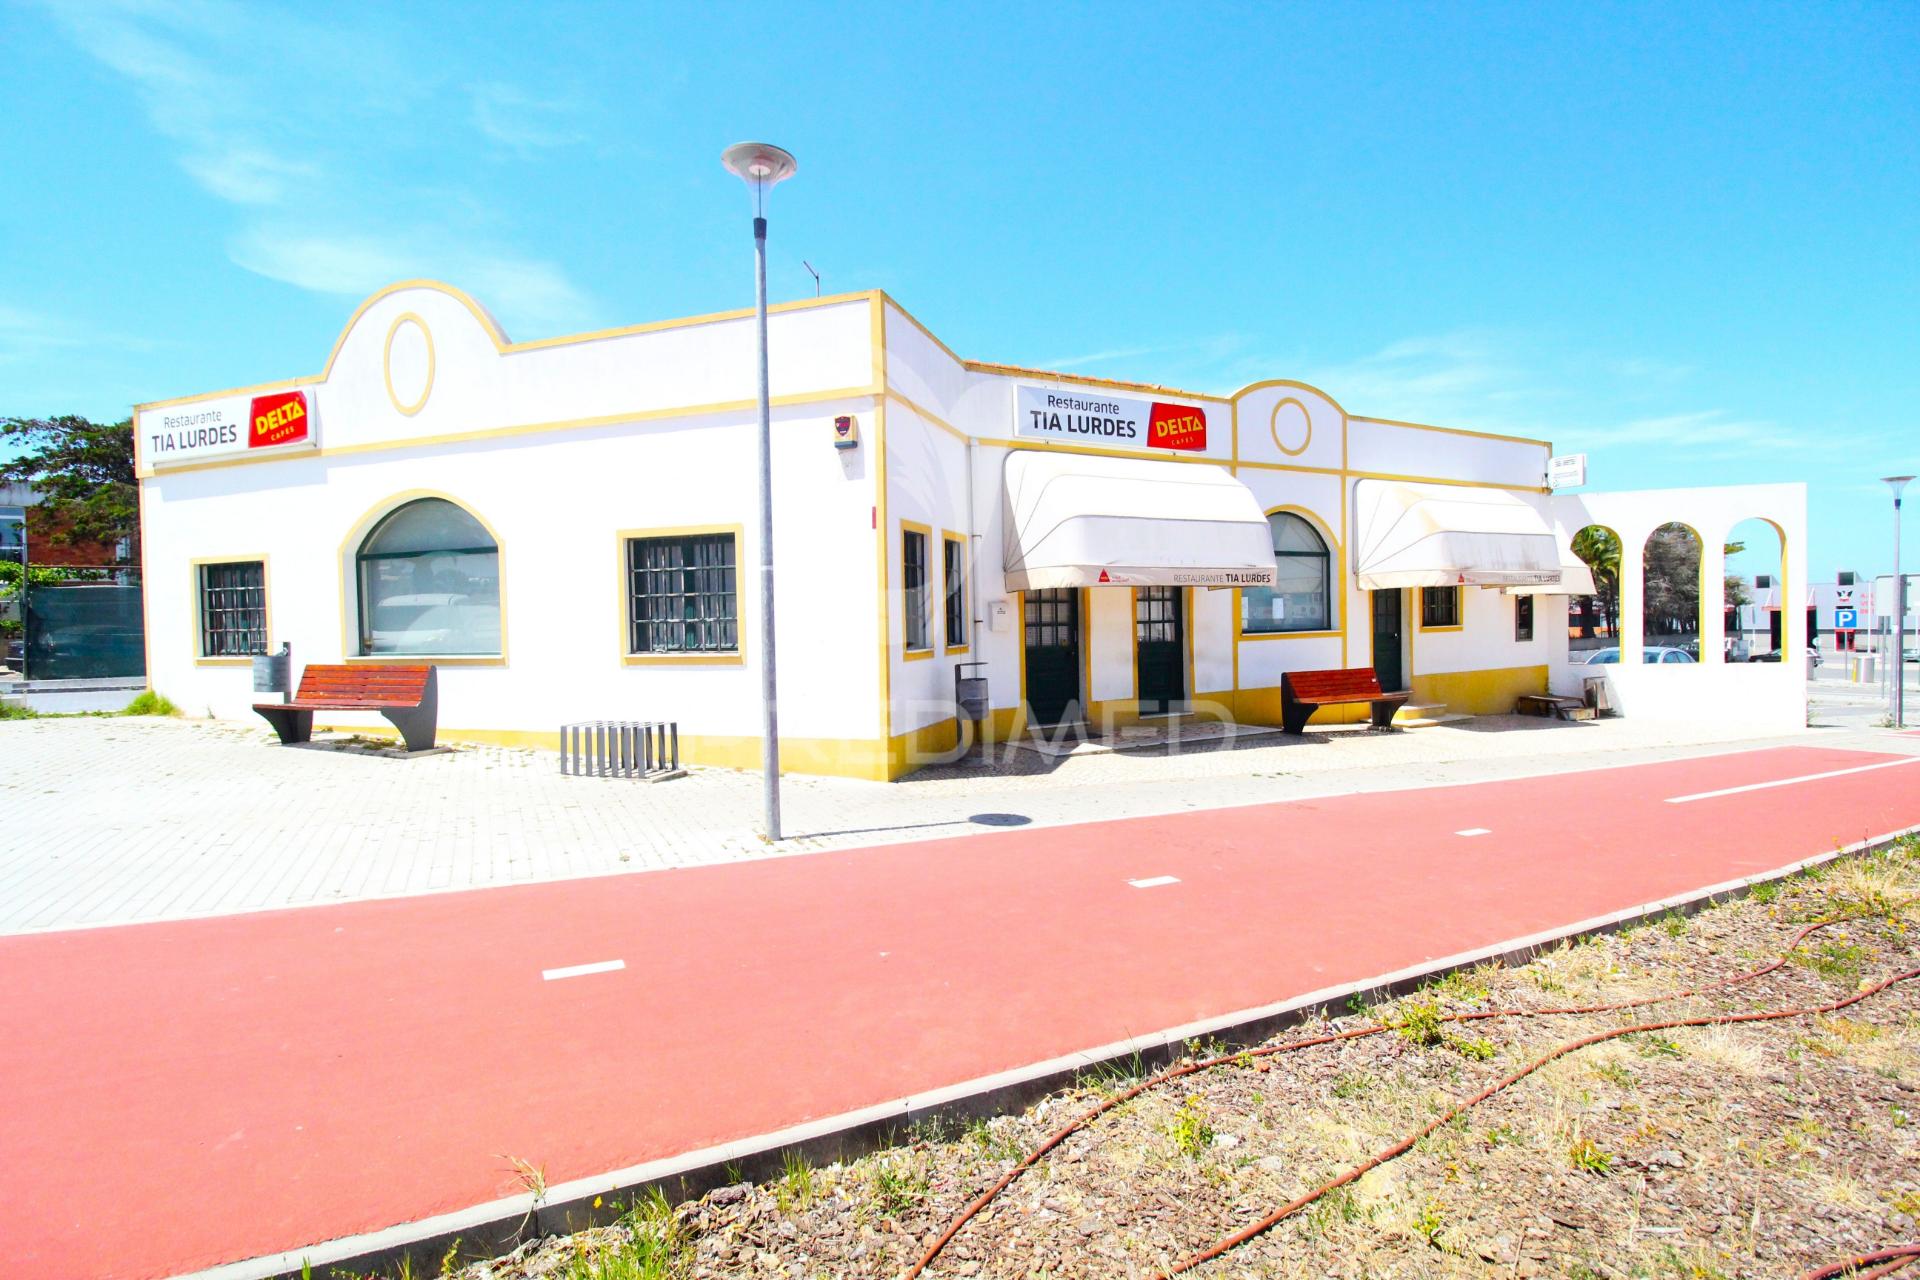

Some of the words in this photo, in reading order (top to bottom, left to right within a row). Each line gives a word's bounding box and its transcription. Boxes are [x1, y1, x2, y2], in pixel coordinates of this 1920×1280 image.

[1047, 394, 1120, 415] Restaurante
[164, 410, 222, 429] Restaurante
[255, 401, 305, 436] DELTA
[1030, 410, 1062, 432] TIA
[1067, 414, 1137, 439] LURDES
[1155, 415, 1204, 438] DELTA
[152, 433, 176, 453] TIA
[179, 424, 237, 449] LURDES
[1173, 574, 1224, 583] RESTAURANTE
[1226, 573, 1240, 583] TIA
[1241, 573, 1271, 583] LURDES
[1838, 611, 1853, 627] P
